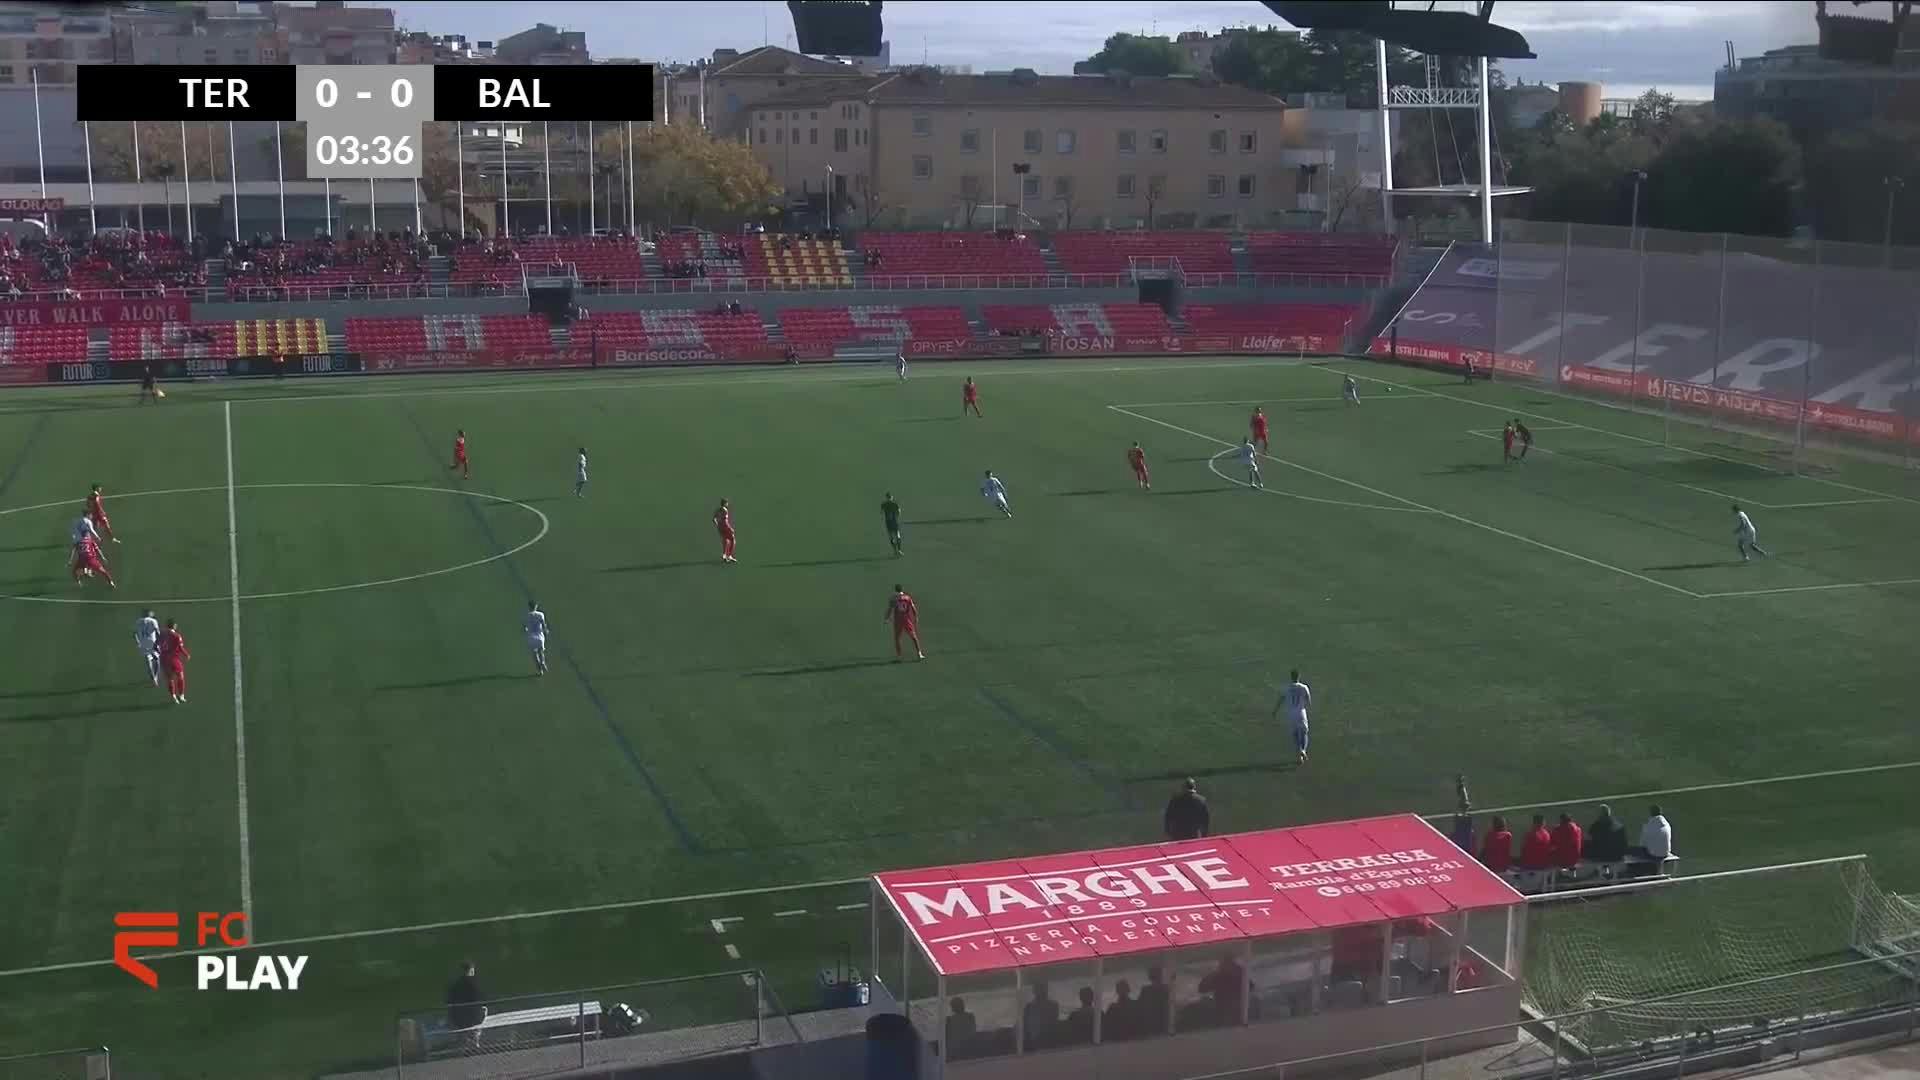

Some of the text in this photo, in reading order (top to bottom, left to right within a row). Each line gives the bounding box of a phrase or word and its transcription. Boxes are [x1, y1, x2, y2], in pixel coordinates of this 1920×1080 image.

[52, 306, 103, 323] WALK
[119, 304, 178, 322] ALONE
[1268, 876, 1347, 890] Rambla
[1431, 860, 1465, 872] 241
[1270, 849, 1439, 877] TERRASSA
[900, 857, 1250, 926] MARGHE
[1429, 873, 1452, 884] 39
[1042, 898, 1148, 919] 1889
[947, 907, 1272, 954] PIZZERIA GOURMET
[1015, 922, 1227, 956] NAPOLETANA
